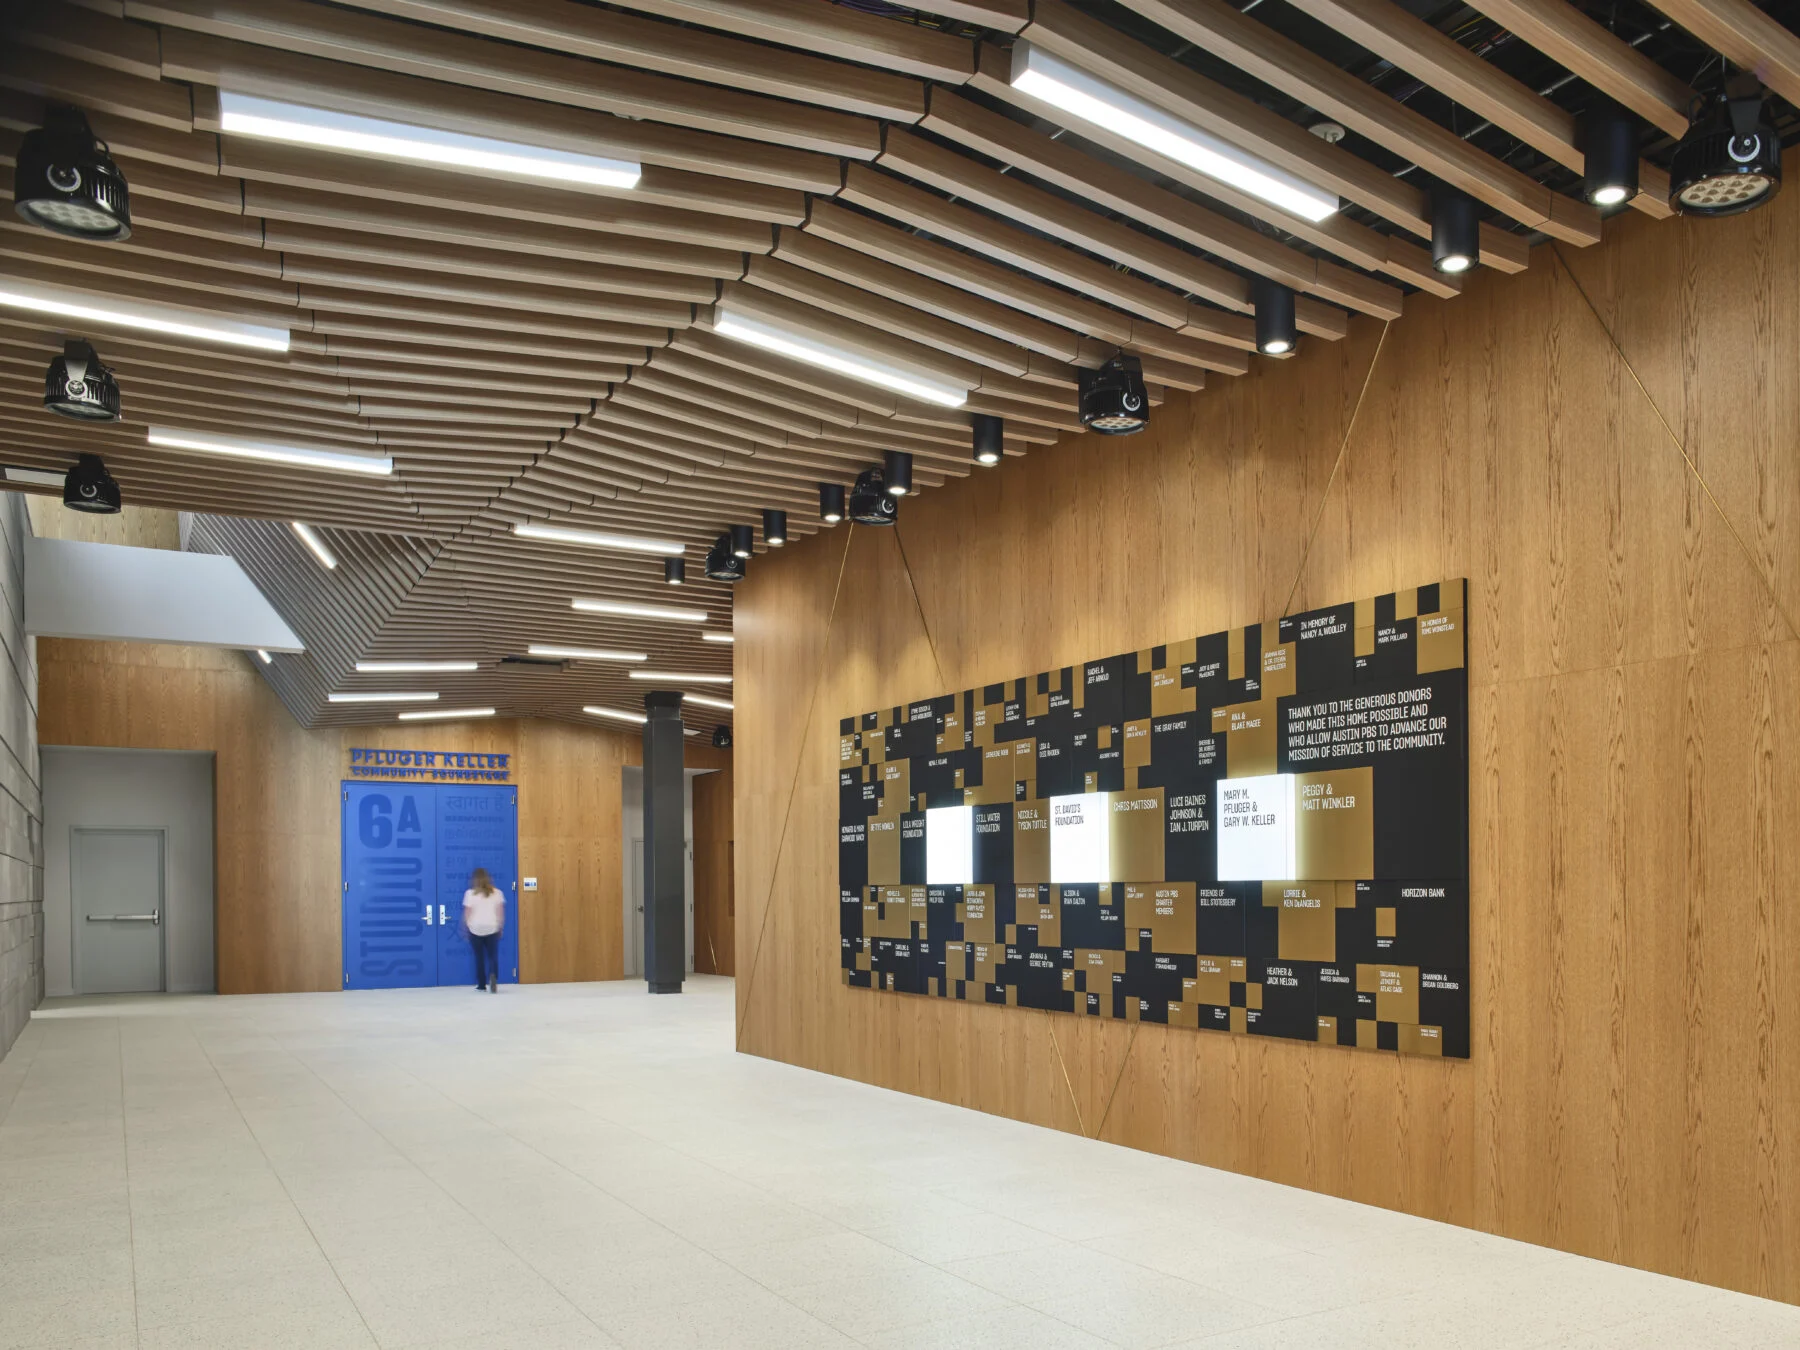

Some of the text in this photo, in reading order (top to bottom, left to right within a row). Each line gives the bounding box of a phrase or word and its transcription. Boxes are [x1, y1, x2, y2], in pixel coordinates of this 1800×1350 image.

[1301, 620, 1307, 630] IN
[1308, 618, 1328, 629] MEMORY
[1329, 616, 1336, 625] OF
[1300, 629, 1317, 640] NANCY
[1324, 624, 1347, 636] WOOLLEY
[1390, 633, 1407, 642] POLLARD
[1288, 688, 1432, 719] THANK YOU TO THE GENEROUS DONORS
[1288, 704, 1428, 733] WHO MADE THIS HOME POSSIBLE AND
[1173, 721, 1186, 730] FAMILY
[1231, 719, 1261, 731] BLAKE MAGEE
[1288, 716, 1447, 747] WHO ALLOW AUSTIN PBS TO ADVANCE OUR
[1288, 732, 1445, 761] MISSION OF SERVICE TO THE COMMUNITY.
[352, 749, 508, 769] PFLUGER KELLER
[352, 766, 510, 781] COMMUNITY SOUNDSTAGE
[1224, 789, 1249, 801] MARY M.
[1303, 784, 1333, 796] PEGGY &
[1114, 799, 1158, 812] CHRIS MATTSSON
[1170, 794, 1206, 807] LUCI BAINES
[1302, 796, 1355, 810] MATT WINKLER
[1063, 804, 1080, 813] DAVID'S
[1170, 808, 1202, 820] JOHNSON &
[1224, 802, 1258, 814] PFLUGER &
[976, 812, 1000, 823] STILL WATER
[1018, 809, 1038, 820] NICOLE &
[1055, 815, 1084, 825] FOUNDATION
[358, 793, 422, 850] 6A
[1018, 819, 1047, 830] TYSON TUTTLE
[1170, 820, 1208, 833] IAN J. TURPIN
[1224, 814, 1275, 828] GARY W. KELLER
[903, 829, 923, 838] FOUNDATION
[976, 823, 1000, 833] FOUNDATION
[1284, 890, 1301, 898] LORRIE
[1402, 888, 1445, 898] HORIZON BANK
[1294, 900, 1320, 908] DeANGELIS
[360, 856, 424, 977] STUDIO
[1267, 967, 1292, 977] HEATHER &
[1267, 977, 1298, 987] JACK NELSON
